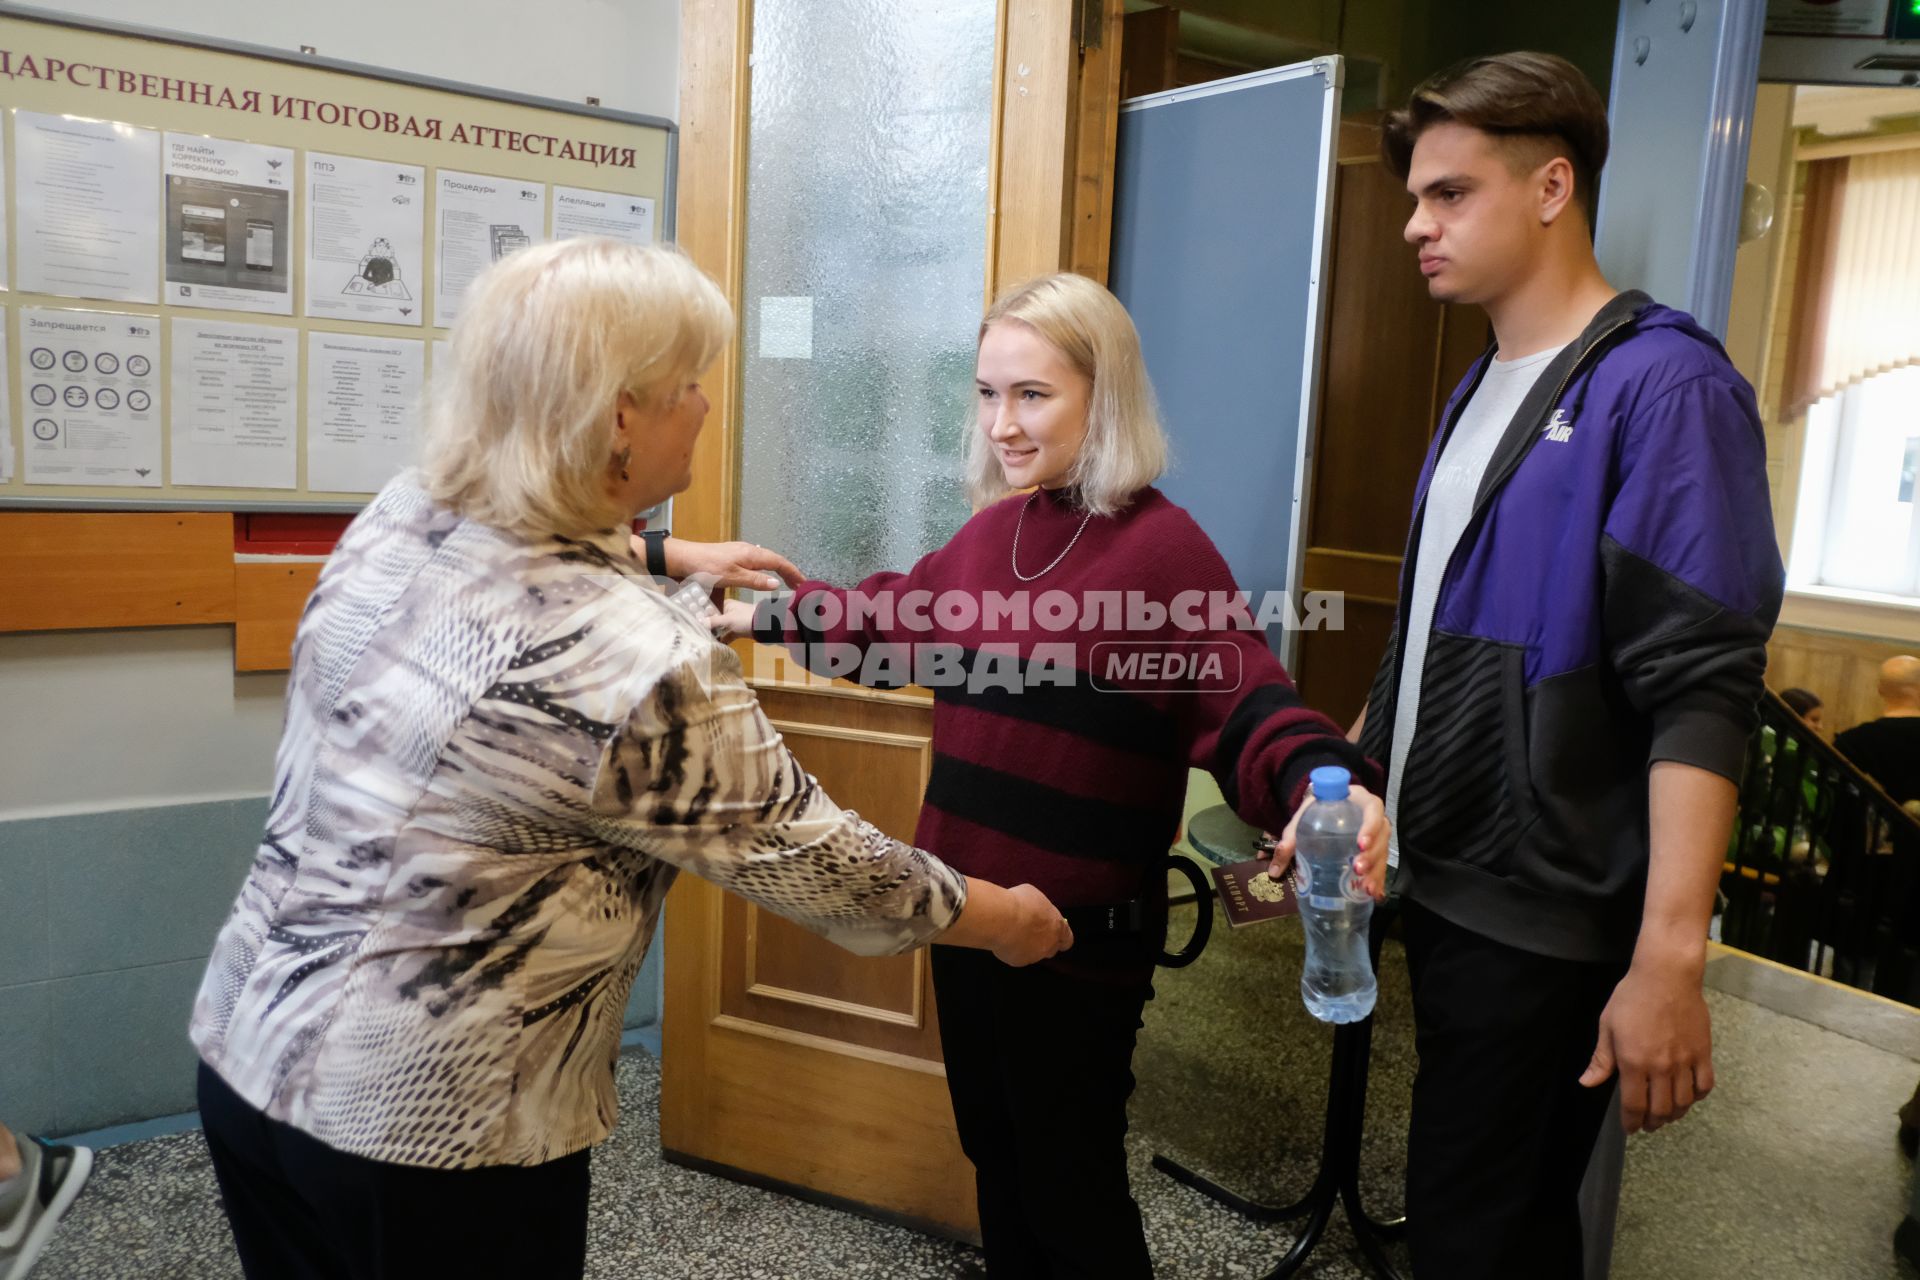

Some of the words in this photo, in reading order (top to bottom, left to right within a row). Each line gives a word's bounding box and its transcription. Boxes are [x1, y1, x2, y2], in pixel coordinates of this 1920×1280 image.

[271, 94, 442, 141] ИТОГОВАЯ
[449, 122, 637, 169] АТТЕСТАЦИЯ
[171, 143, 185, 152] ГДЕ
[186, 145, 215, 155] НАЙТИ
[171, 153, 226, 167] КОРРЕКТНУЮ
[313, 161, 336, 172] ППЭ
[171, 160, 240, 177] ИНФОРМАЦИЮ?
[443, 179, 497, 195] Процедуры
[559, 194, 606, 209] Апелляция
[30, 318, 106, 333] Запрещается
[1545, 425, 1574, 443] AIR
